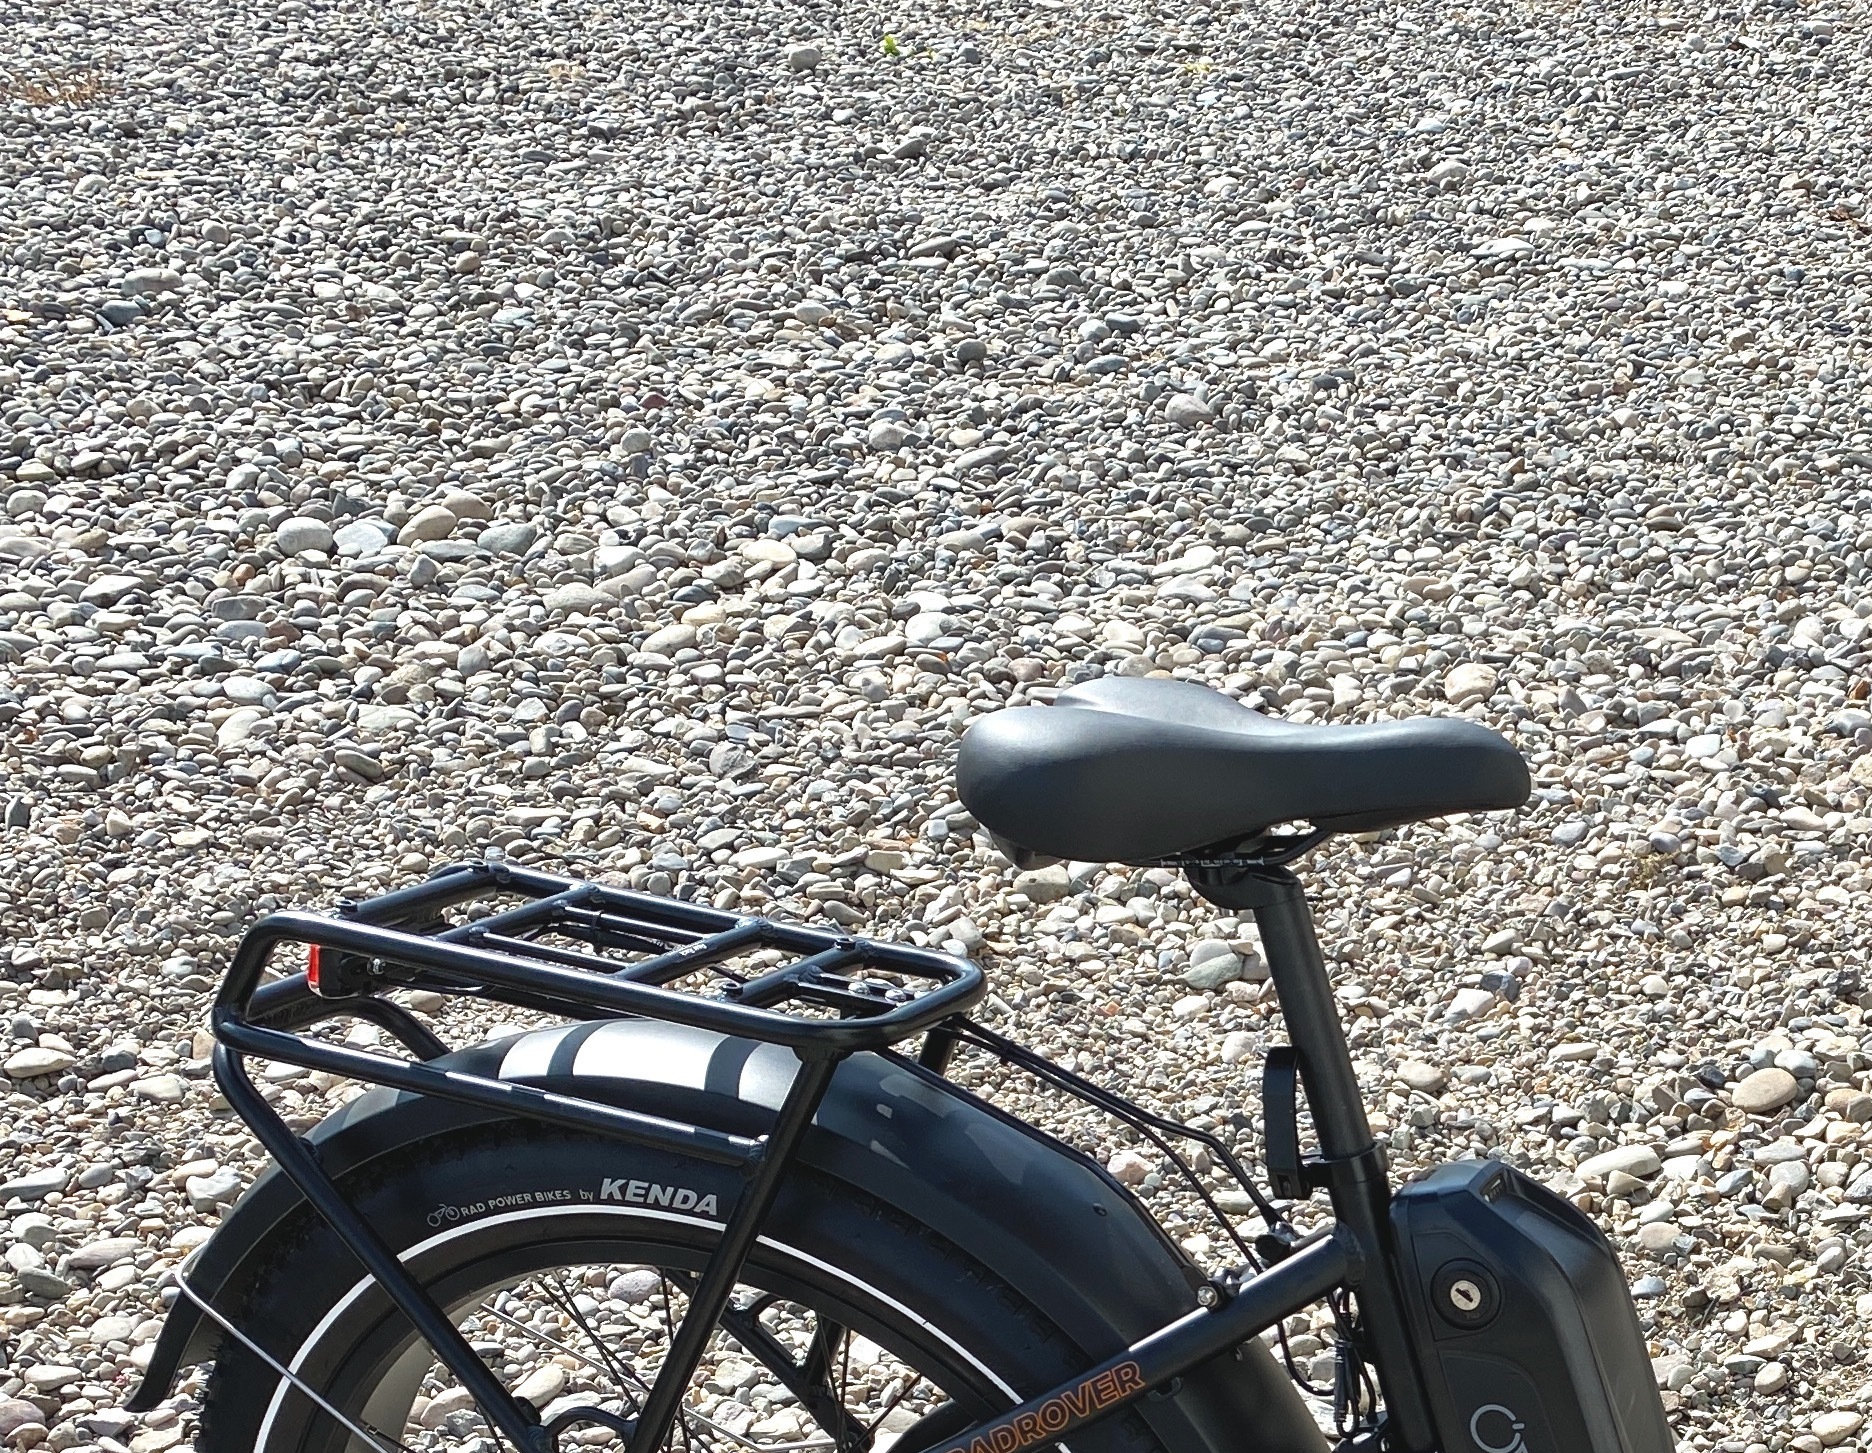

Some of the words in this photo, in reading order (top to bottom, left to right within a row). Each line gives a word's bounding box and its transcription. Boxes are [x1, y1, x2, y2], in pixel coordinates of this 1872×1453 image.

[459, 1202, 486, 1217] RAD
[488, 1192, 533, 1210] POWER
[535, 1189, 571, 1202] BIKES
[579, 1188, 594, 1202] by
[600, 1178, 718, 1216] KENDA
